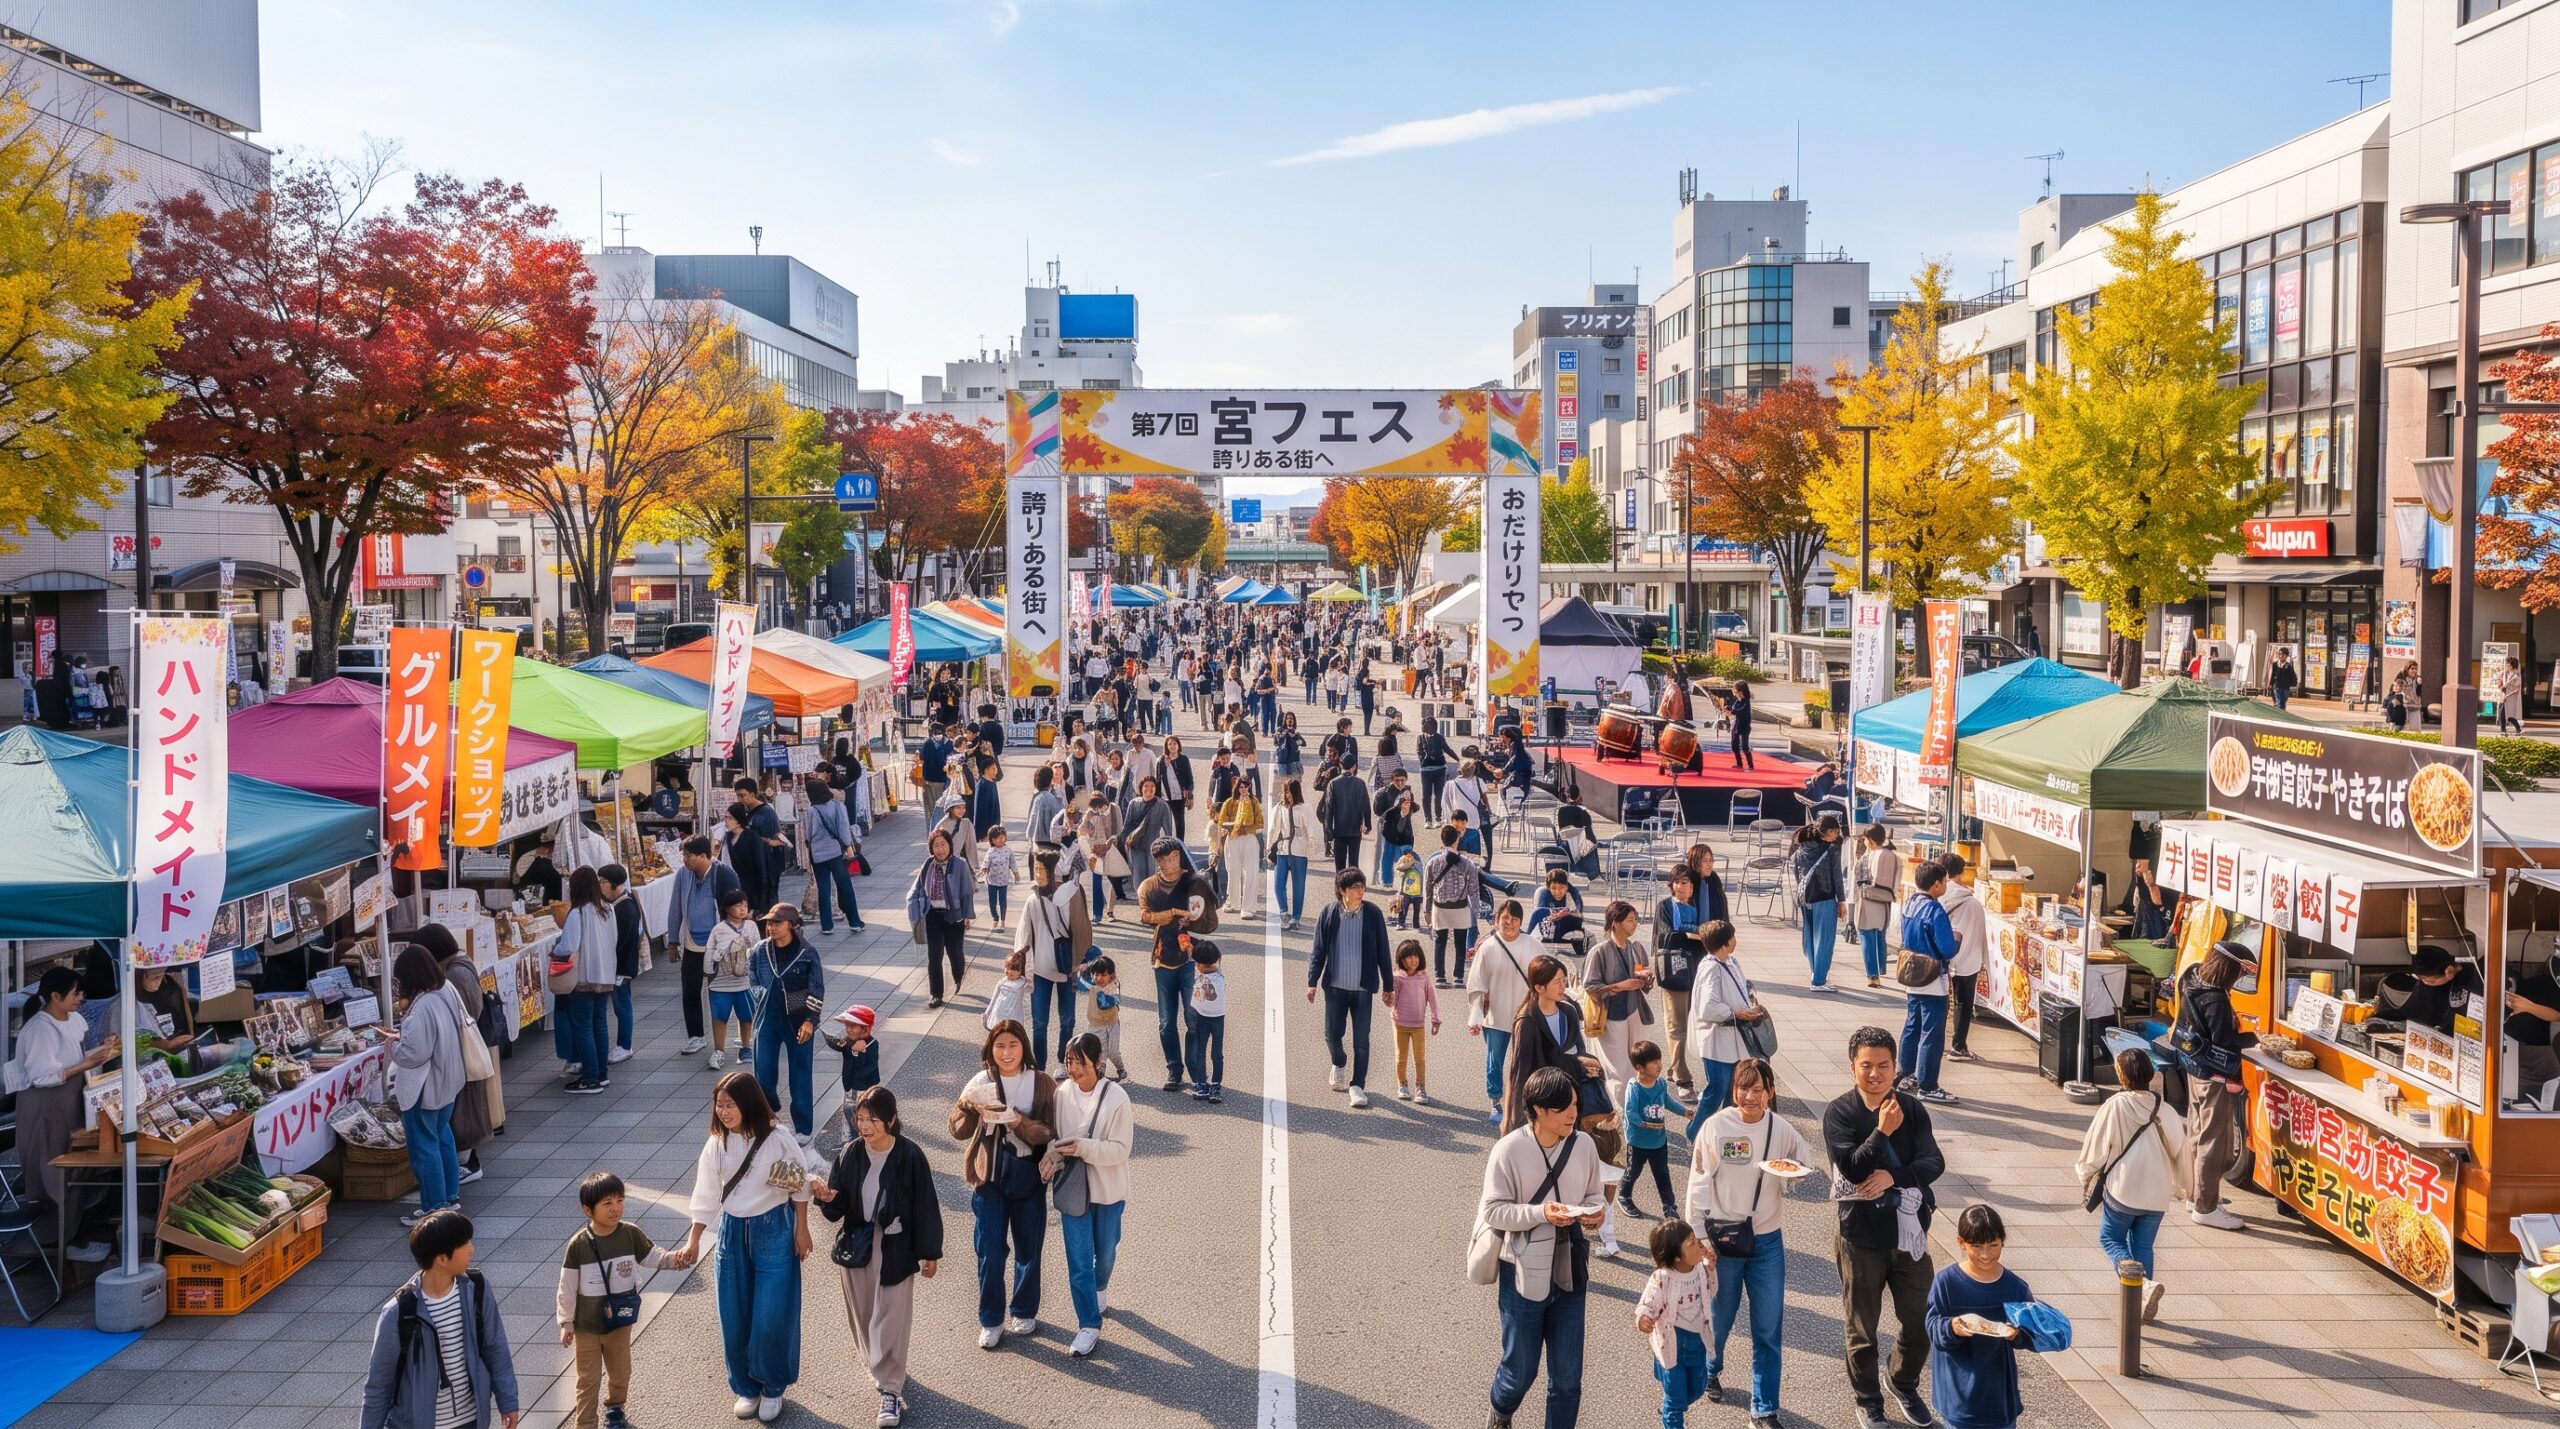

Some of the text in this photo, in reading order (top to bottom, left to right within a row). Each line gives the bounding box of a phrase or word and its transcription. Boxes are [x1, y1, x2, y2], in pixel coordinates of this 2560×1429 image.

[1131, 397, 1413, 444] 第7回 宮フェス
[1213, 450, 1334, 469] 誇りある街へ
[1022, 492, 1047, 635] 誇りある街へ
[152, 661, 201, 932] ハンドメイド
[462, 641, 501, 836] ワークショップ
[2271, 1147, 2377, 1243] やきそば
